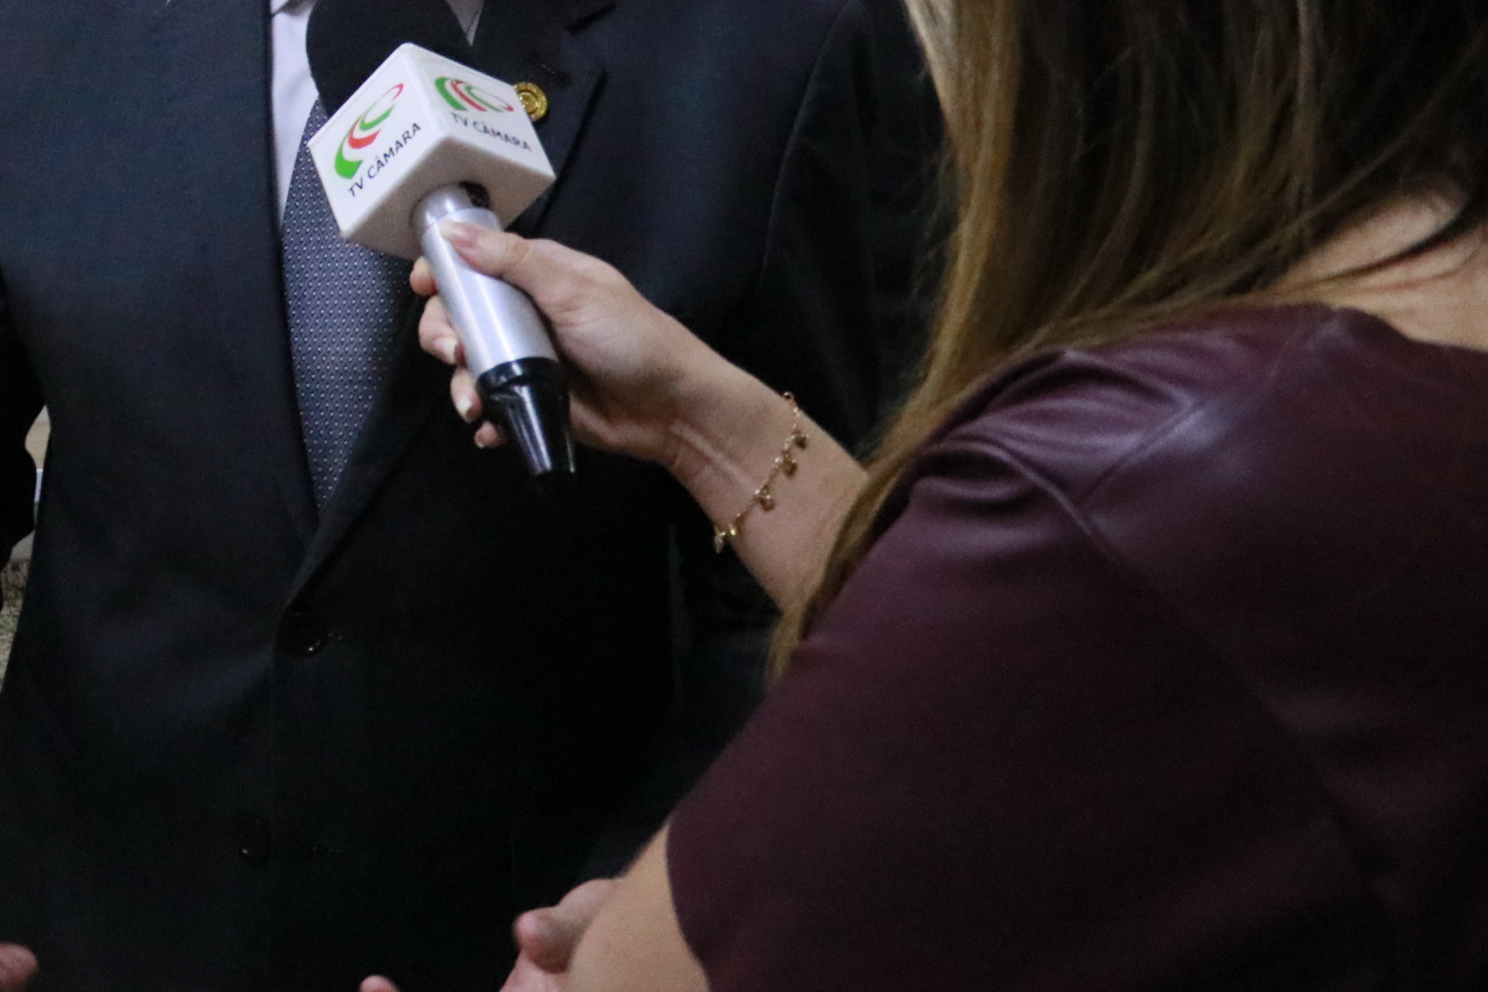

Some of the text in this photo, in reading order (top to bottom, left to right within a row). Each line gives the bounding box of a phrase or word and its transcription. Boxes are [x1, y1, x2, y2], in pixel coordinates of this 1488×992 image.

[450, 112, 467, 126] TV
[348, 122, 421, 197] TV CÂMARA
